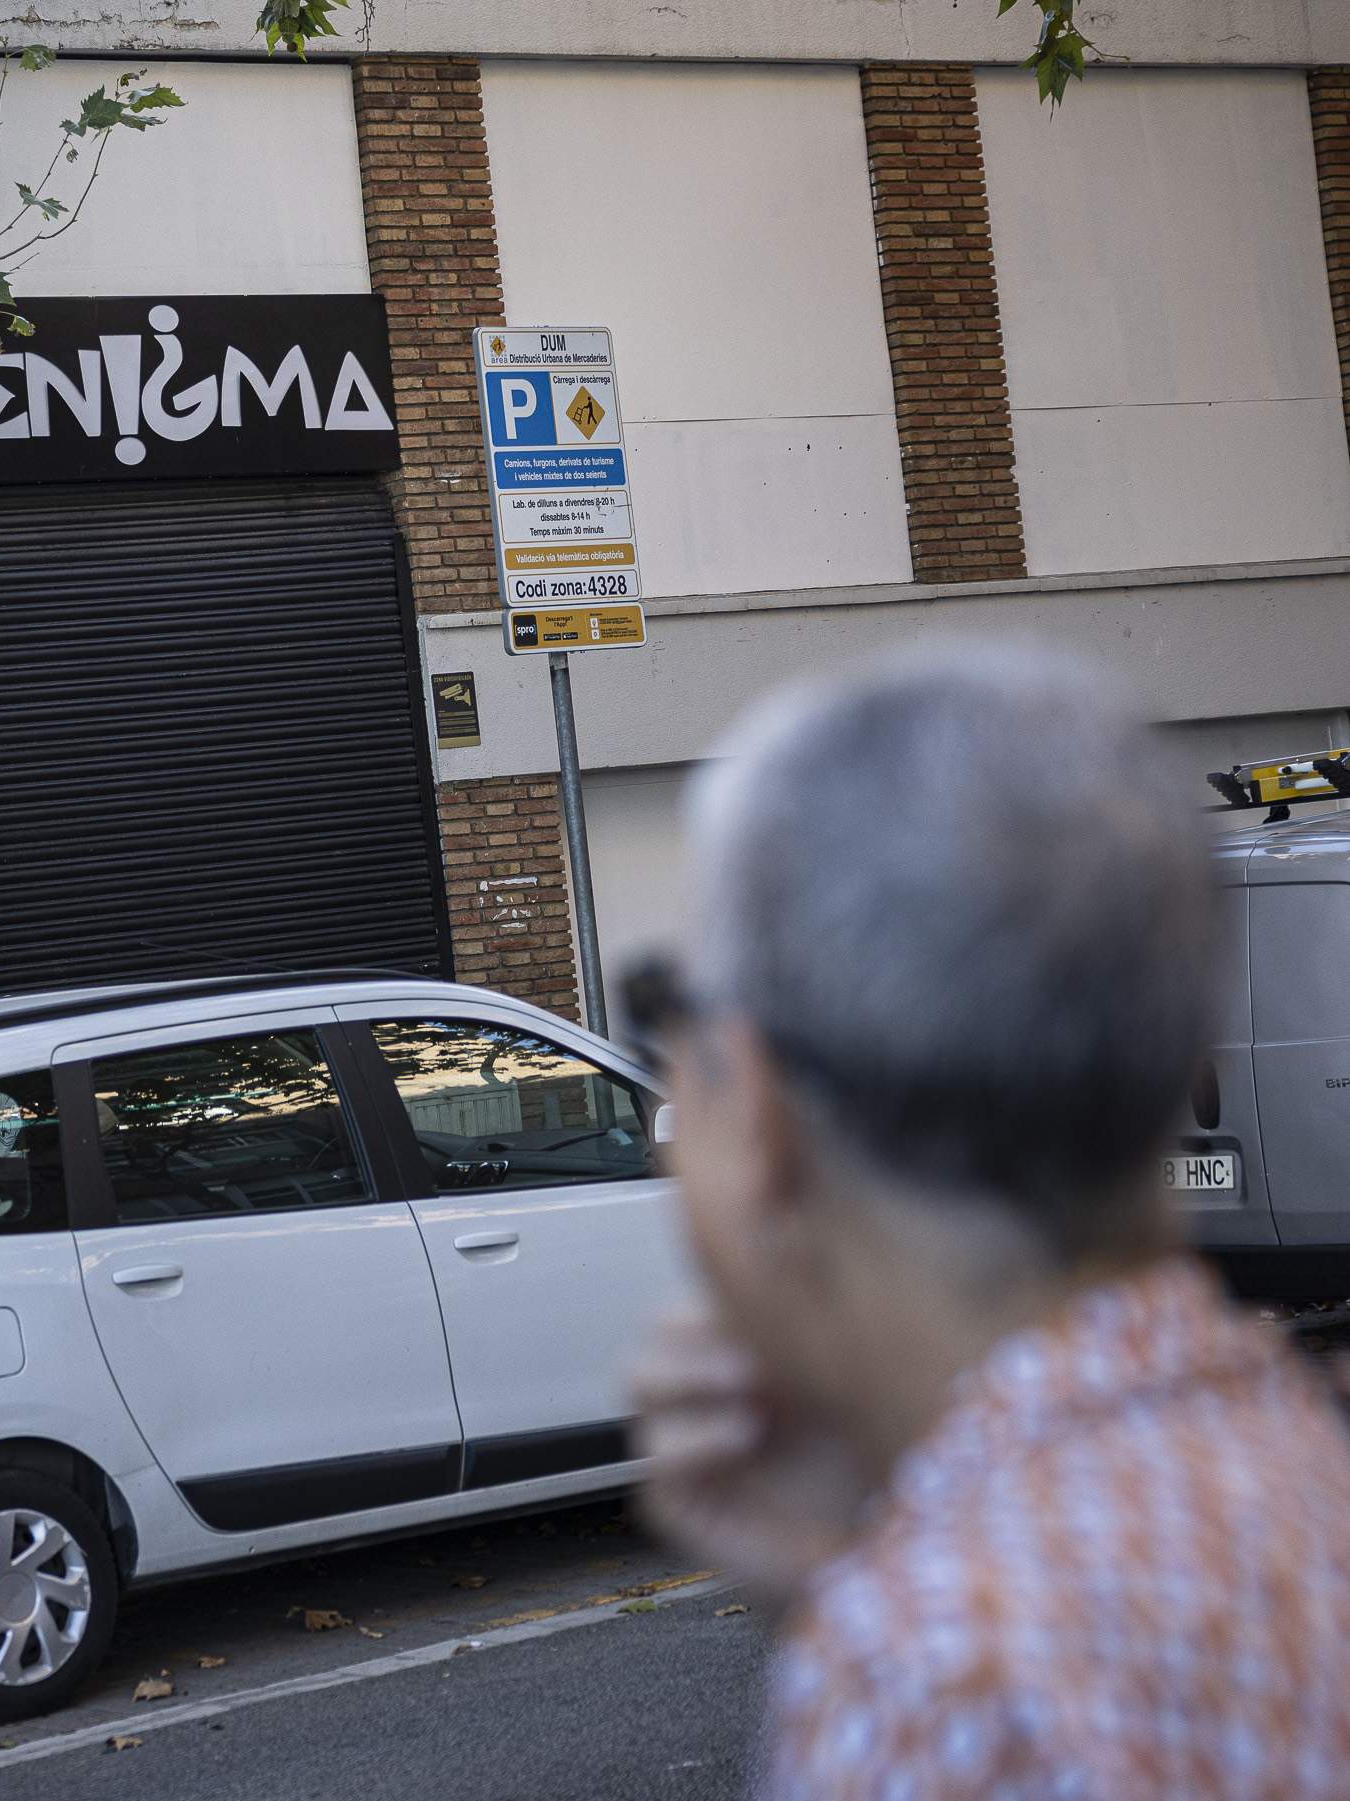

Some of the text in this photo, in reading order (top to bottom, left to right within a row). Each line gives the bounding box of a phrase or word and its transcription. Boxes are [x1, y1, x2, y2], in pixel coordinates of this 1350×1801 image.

[540, 334, 566, 351] DUM
[509, 353, 608, 363] Distribució Urbana de Mercaderies
[553, 376, 575, 385] Càrrega
[579, 375, 611, 385] descàrrega
[500, 378, 537, 440] P
[558, 458, 582, 466] derivats
[583, 457, 591, 466] de
[591, 456, 614, 465] turisme
[518, 472, 543, 480] vehicles
[564, 471, 572, 479] de
[573, 471, 585, 479] dos
[512, 500, 527, 509] Lab.
[527, 499, 536, 508] de
[537, 499, 558, 508] dilluns
[564, 497, 595, 507] divendres
[595, 497, 609, 506] 8-20
[610, 497, 615, 505] h
[540, 511, 591, 522] dissabtes 8-14 h
[529, 525, 604, 538] Temps màxim 30 minuts
[515, 553, 545, 564] Validació
[515, 579, 547, 598] Codi
[1186, 1159, 1226, 1187] HNC
